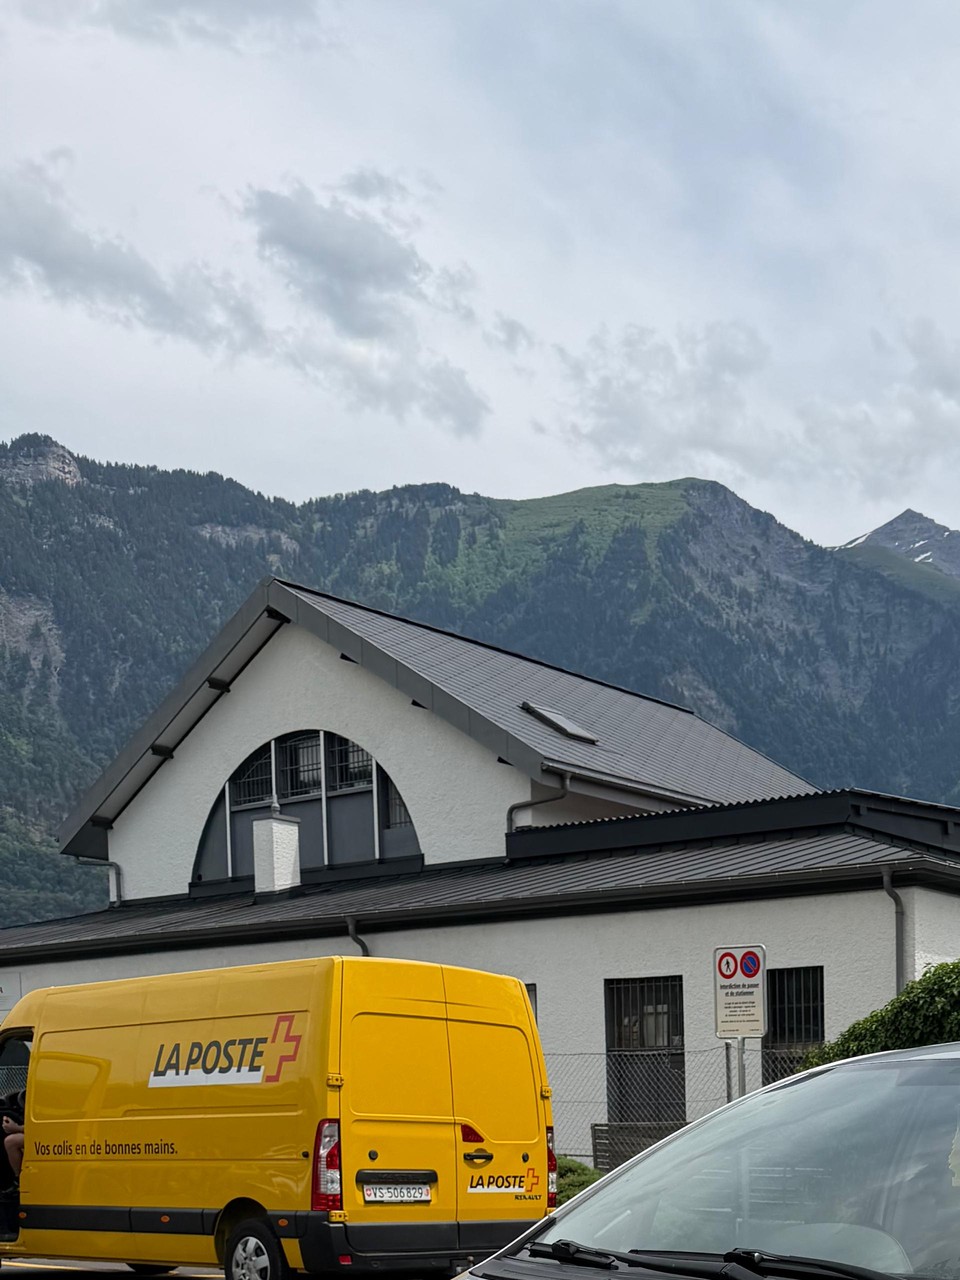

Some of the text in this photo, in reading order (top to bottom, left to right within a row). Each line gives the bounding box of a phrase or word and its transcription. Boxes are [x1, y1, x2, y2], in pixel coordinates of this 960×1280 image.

[153, 1037, 269, 1077] LA POSTE
[34, 1138, 178, 1155] Vos colis en de bonnes mains.
[469, 1175, 525, 1189] LA POSTE
